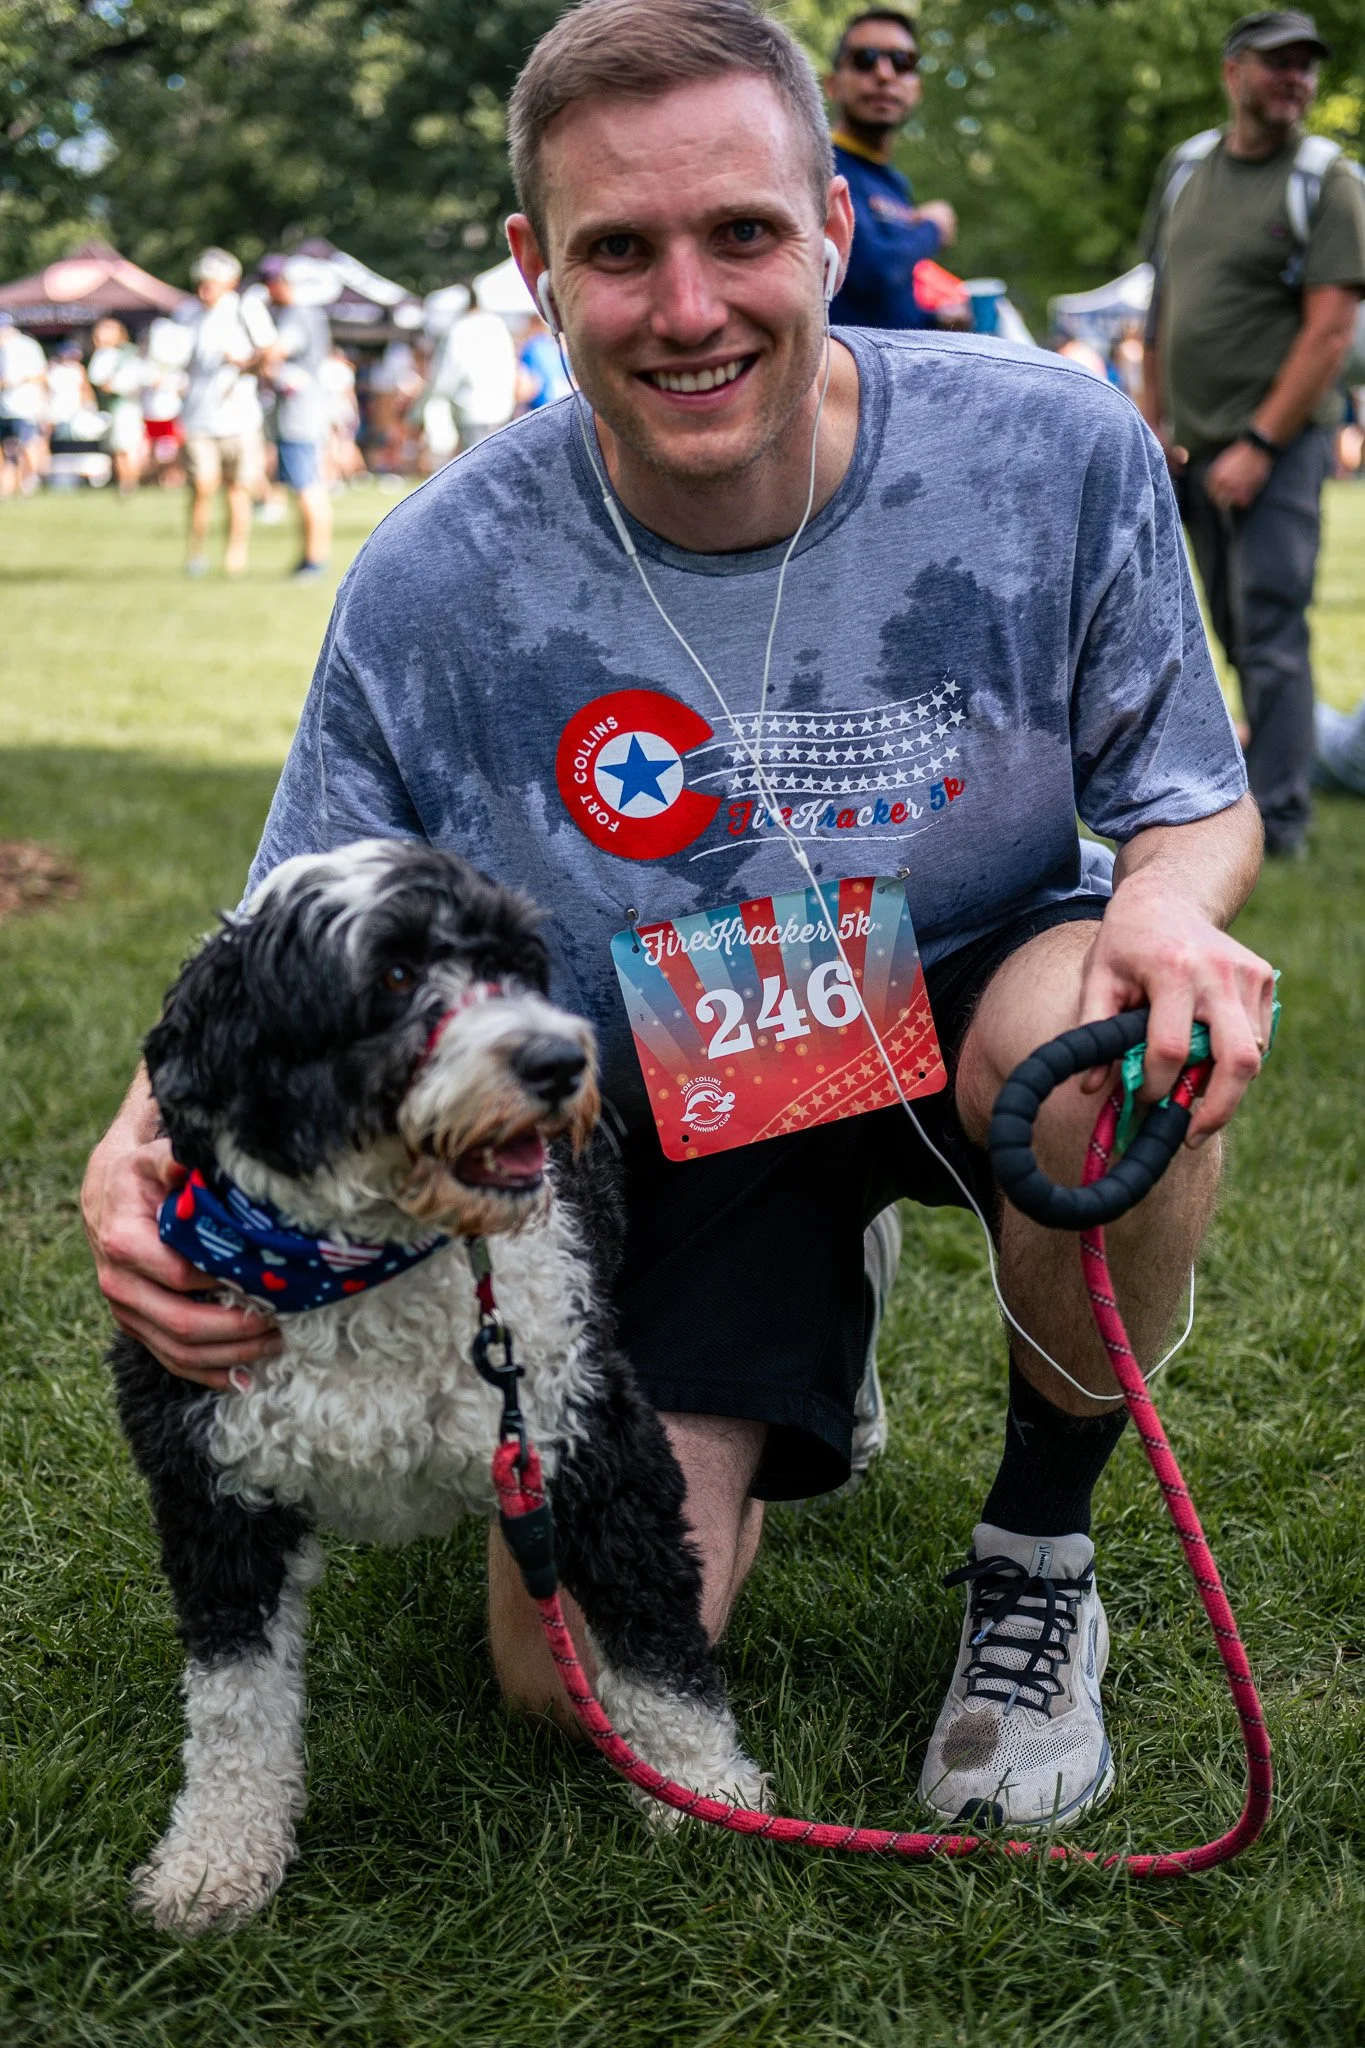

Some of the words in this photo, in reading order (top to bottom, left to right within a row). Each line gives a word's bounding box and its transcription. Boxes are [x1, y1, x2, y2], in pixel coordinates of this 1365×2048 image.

[573, 716, 619, 784] COLLINS
[580, 794, 620, 833] FORT
[640, 916, 832, 966] FireKracker
[838, 910, 876, 940] 5k
[694, 960, 864, 1060] 246
[680, 1080, 695, 1094] FORT
[695, 1076, 722, 1086] COLLINS
[689, 1122, 718, 1132] RUNNING
[718, 1113, 730, 1127] CLUB
